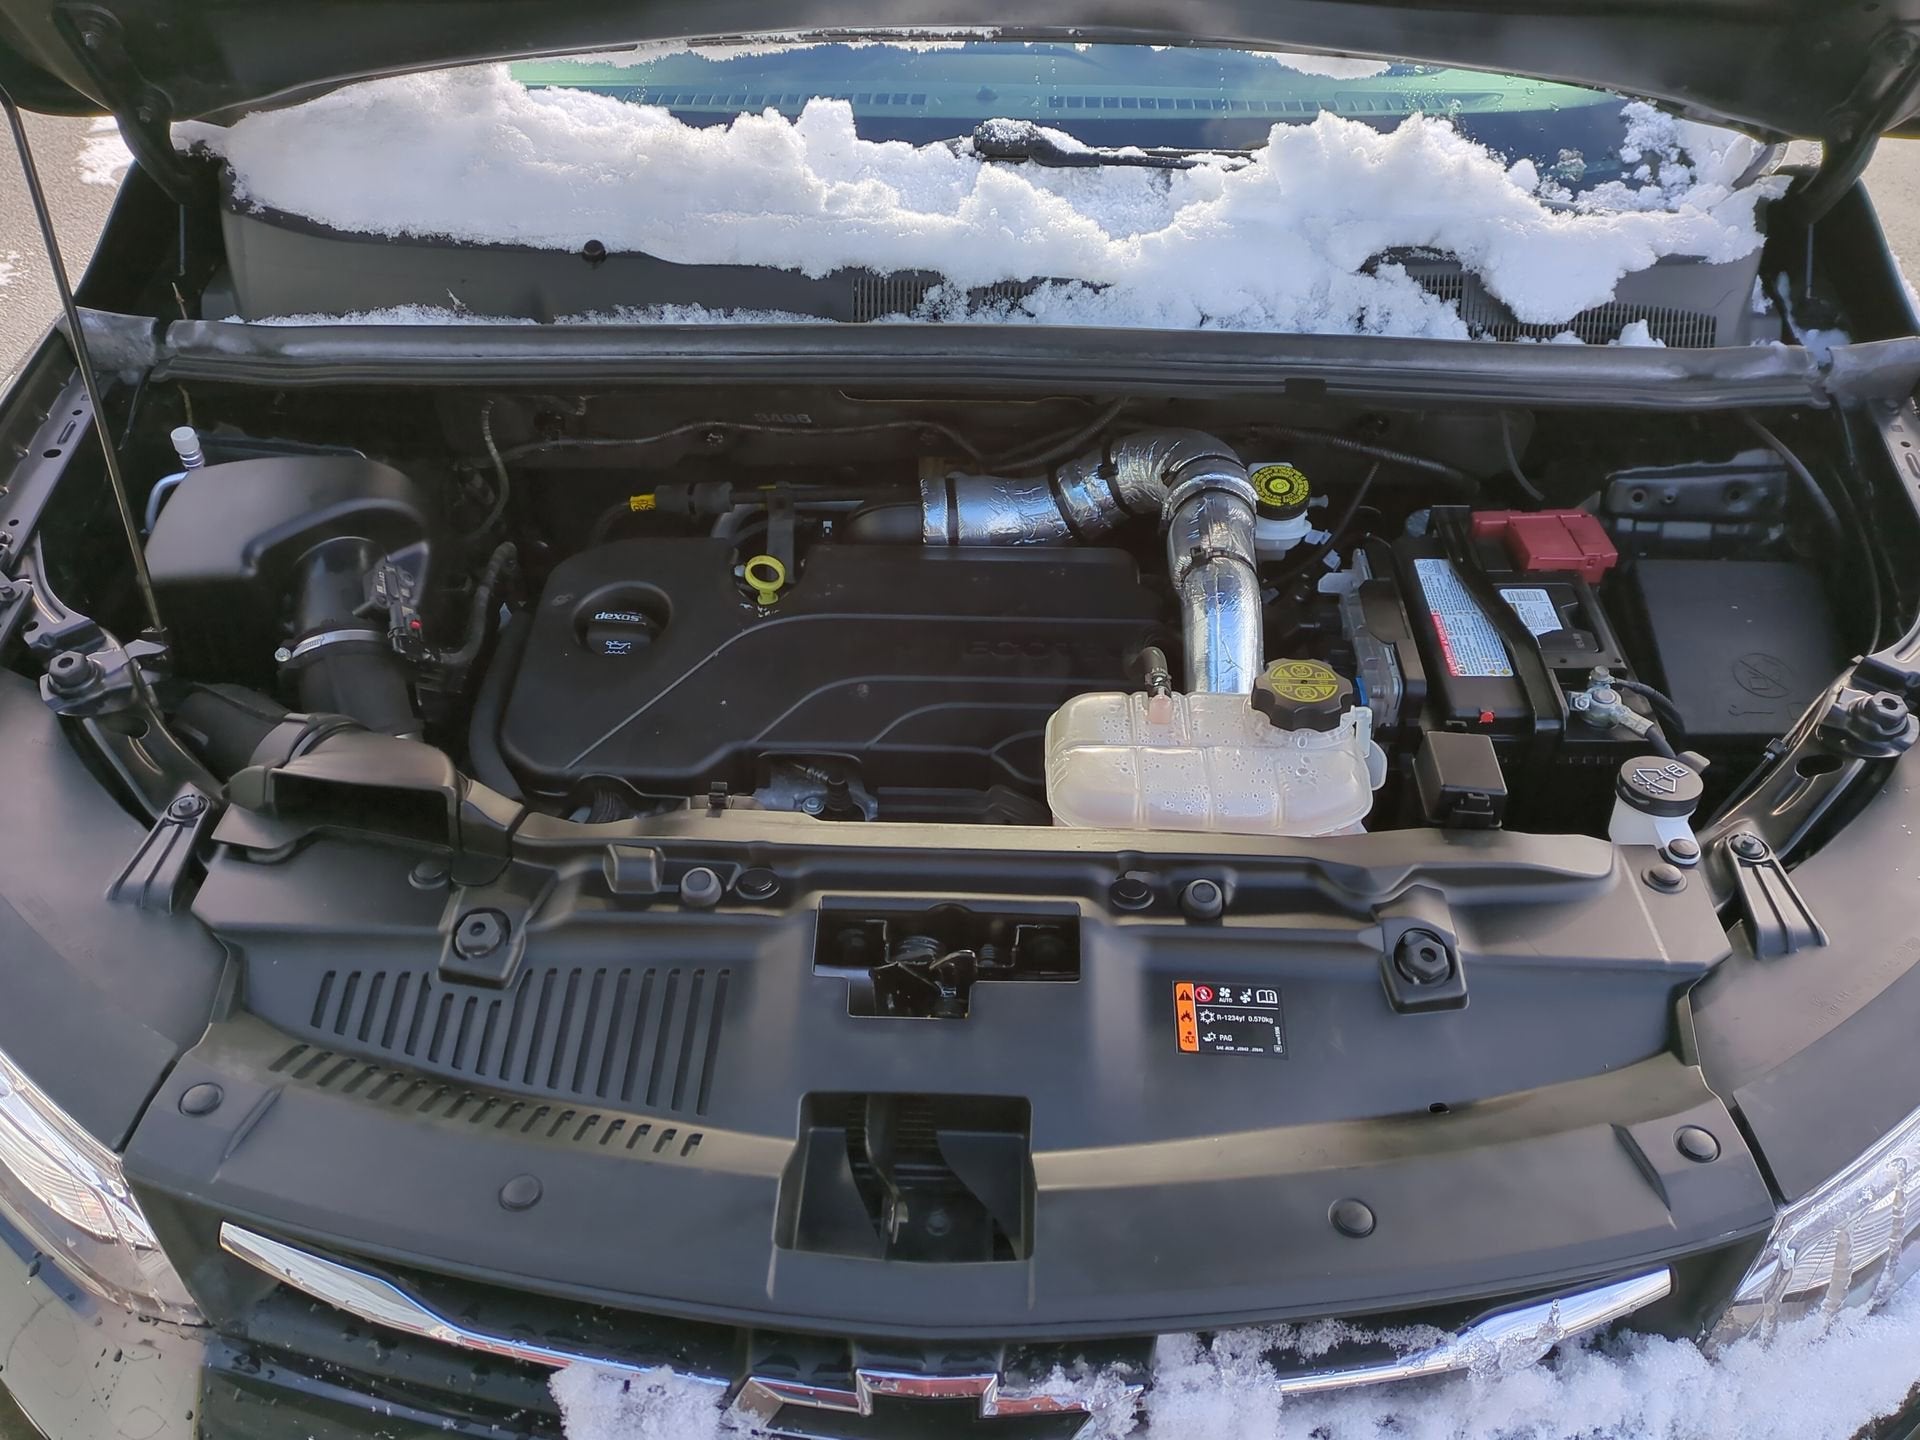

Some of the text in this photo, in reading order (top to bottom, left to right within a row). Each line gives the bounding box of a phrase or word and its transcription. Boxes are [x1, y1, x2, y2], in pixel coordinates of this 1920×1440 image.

[595, 611, 641, 622] dexos
[1216, 1014, 1245, 1023] R-1234yf
[1219, 1034, 1233, 1042] PAG
